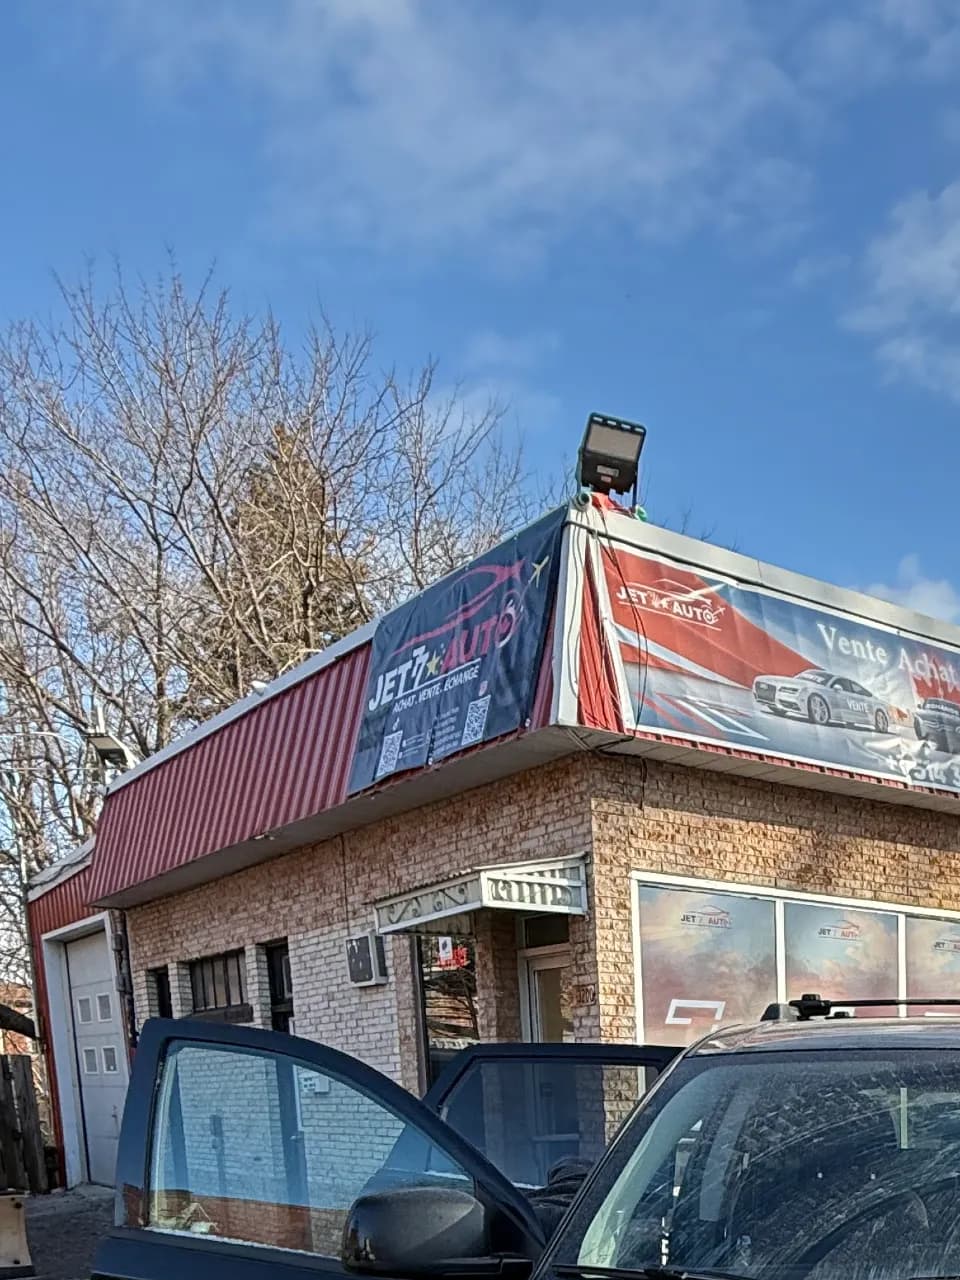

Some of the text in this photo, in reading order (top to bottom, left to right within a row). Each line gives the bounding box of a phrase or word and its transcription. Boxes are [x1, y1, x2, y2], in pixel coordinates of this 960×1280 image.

[672, 601, 717, 625] AUTO
[368, 660, 413, 711] JET
[440, 605, 516, 673] AUTO
[817, 623, 888, 665] Vente
[899, 647, 956, 686] Achat
